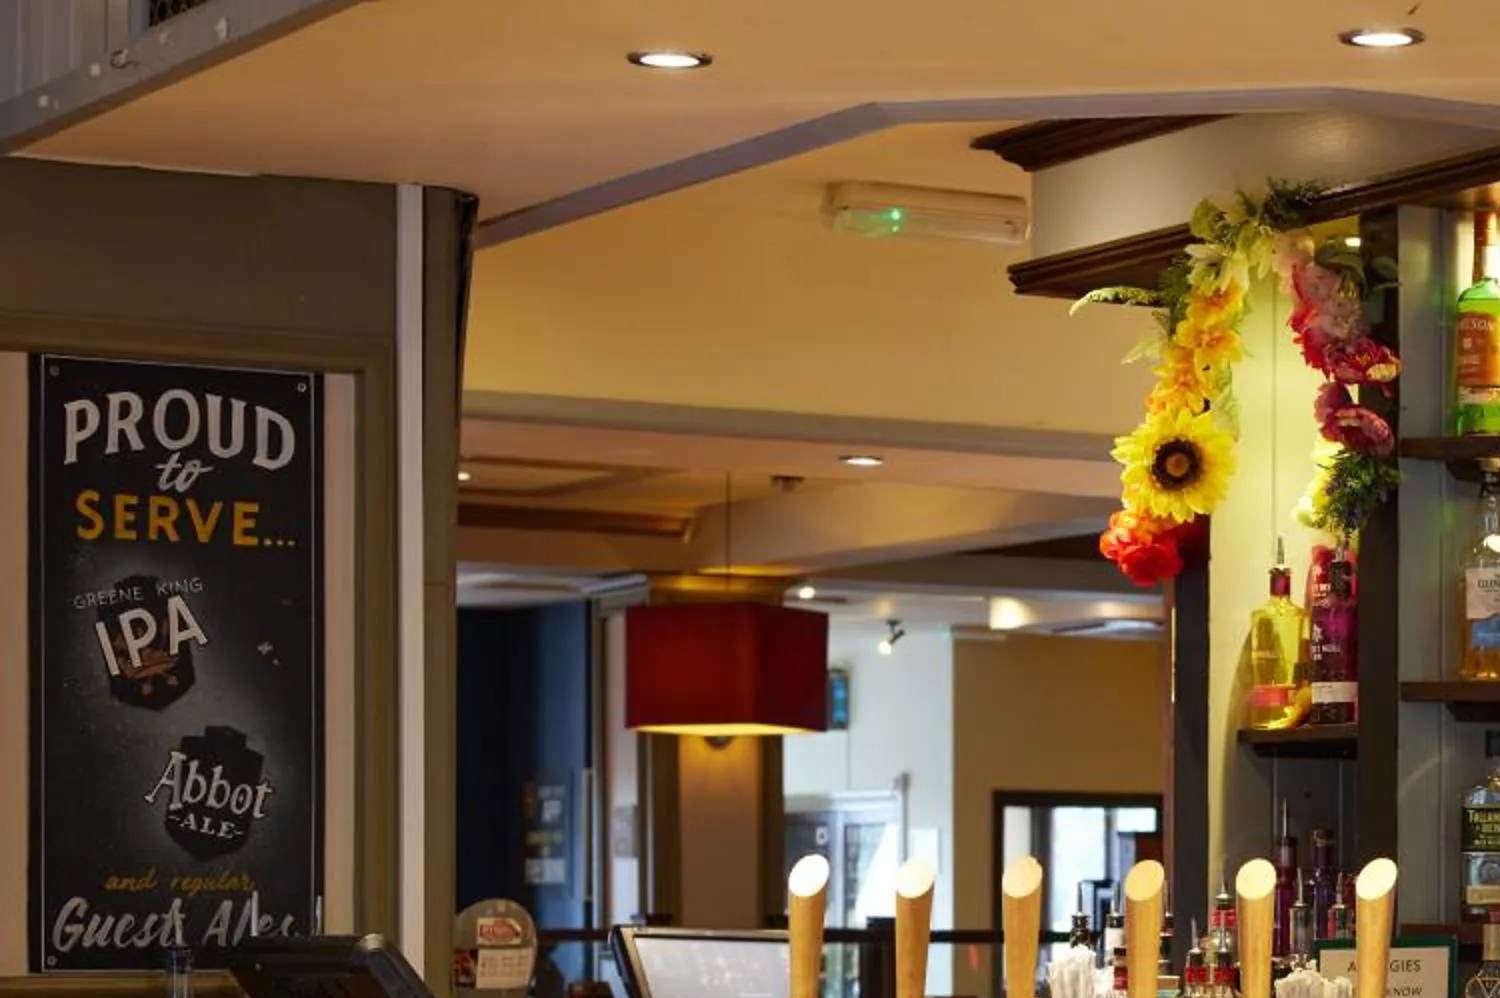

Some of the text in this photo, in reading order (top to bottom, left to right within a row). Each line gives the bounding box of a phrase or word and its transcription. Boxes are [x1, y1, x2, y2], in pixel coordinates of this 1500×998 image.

[63, 389, 296, 471] PROUD
[155, 451, 214, 493] to
[73, 577, 203, 609] GREENE KING
[95, 595, 208, 677] IPA
[144, 751, 274, 819] Abbot
[105, 866, 255, 897] and regular
[53, 896, 187, 952] Guest
[1347, 959, 1422, 973] AGIES
[1387, 986, 1423, 997] NOW
